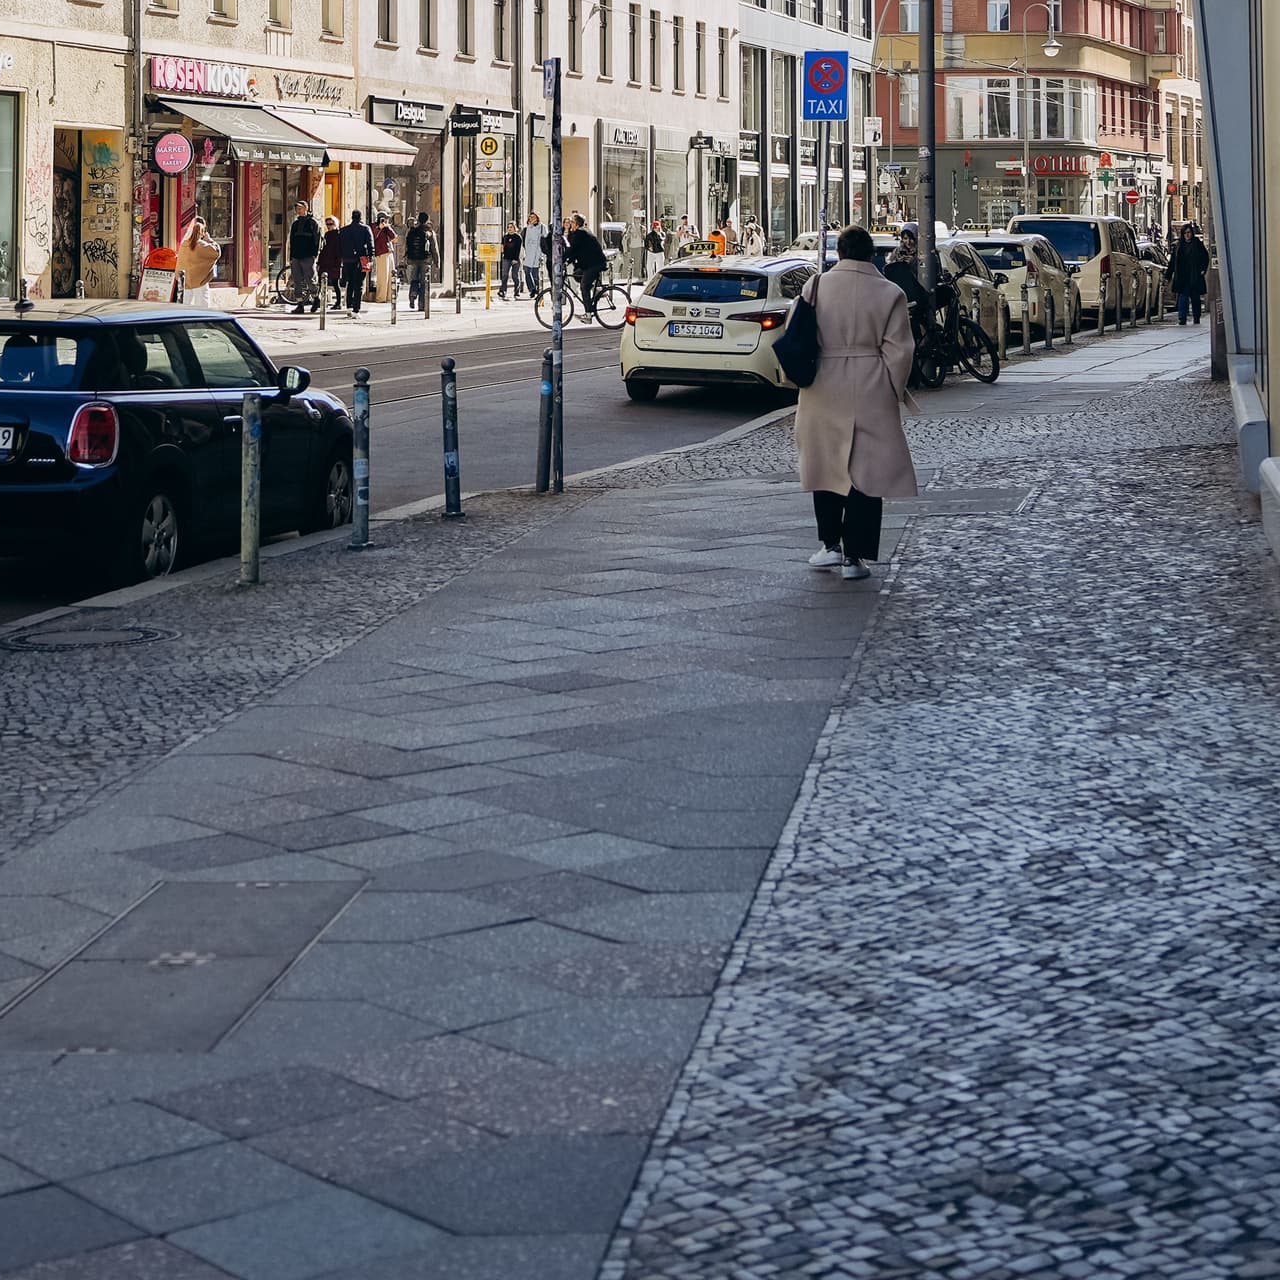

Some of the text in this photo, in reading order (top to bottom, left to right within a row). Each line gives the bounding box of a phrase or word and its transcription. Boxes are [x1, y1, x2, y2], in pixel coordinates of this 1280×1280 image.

[807, 99, 843, 115] TAXI
[157, 145, 186, 153] MARKET
[485, 141, 494, 151] H
[690, 242, 716, 251] TAXI
[675, 325, 721, 336] B SZ 1044
